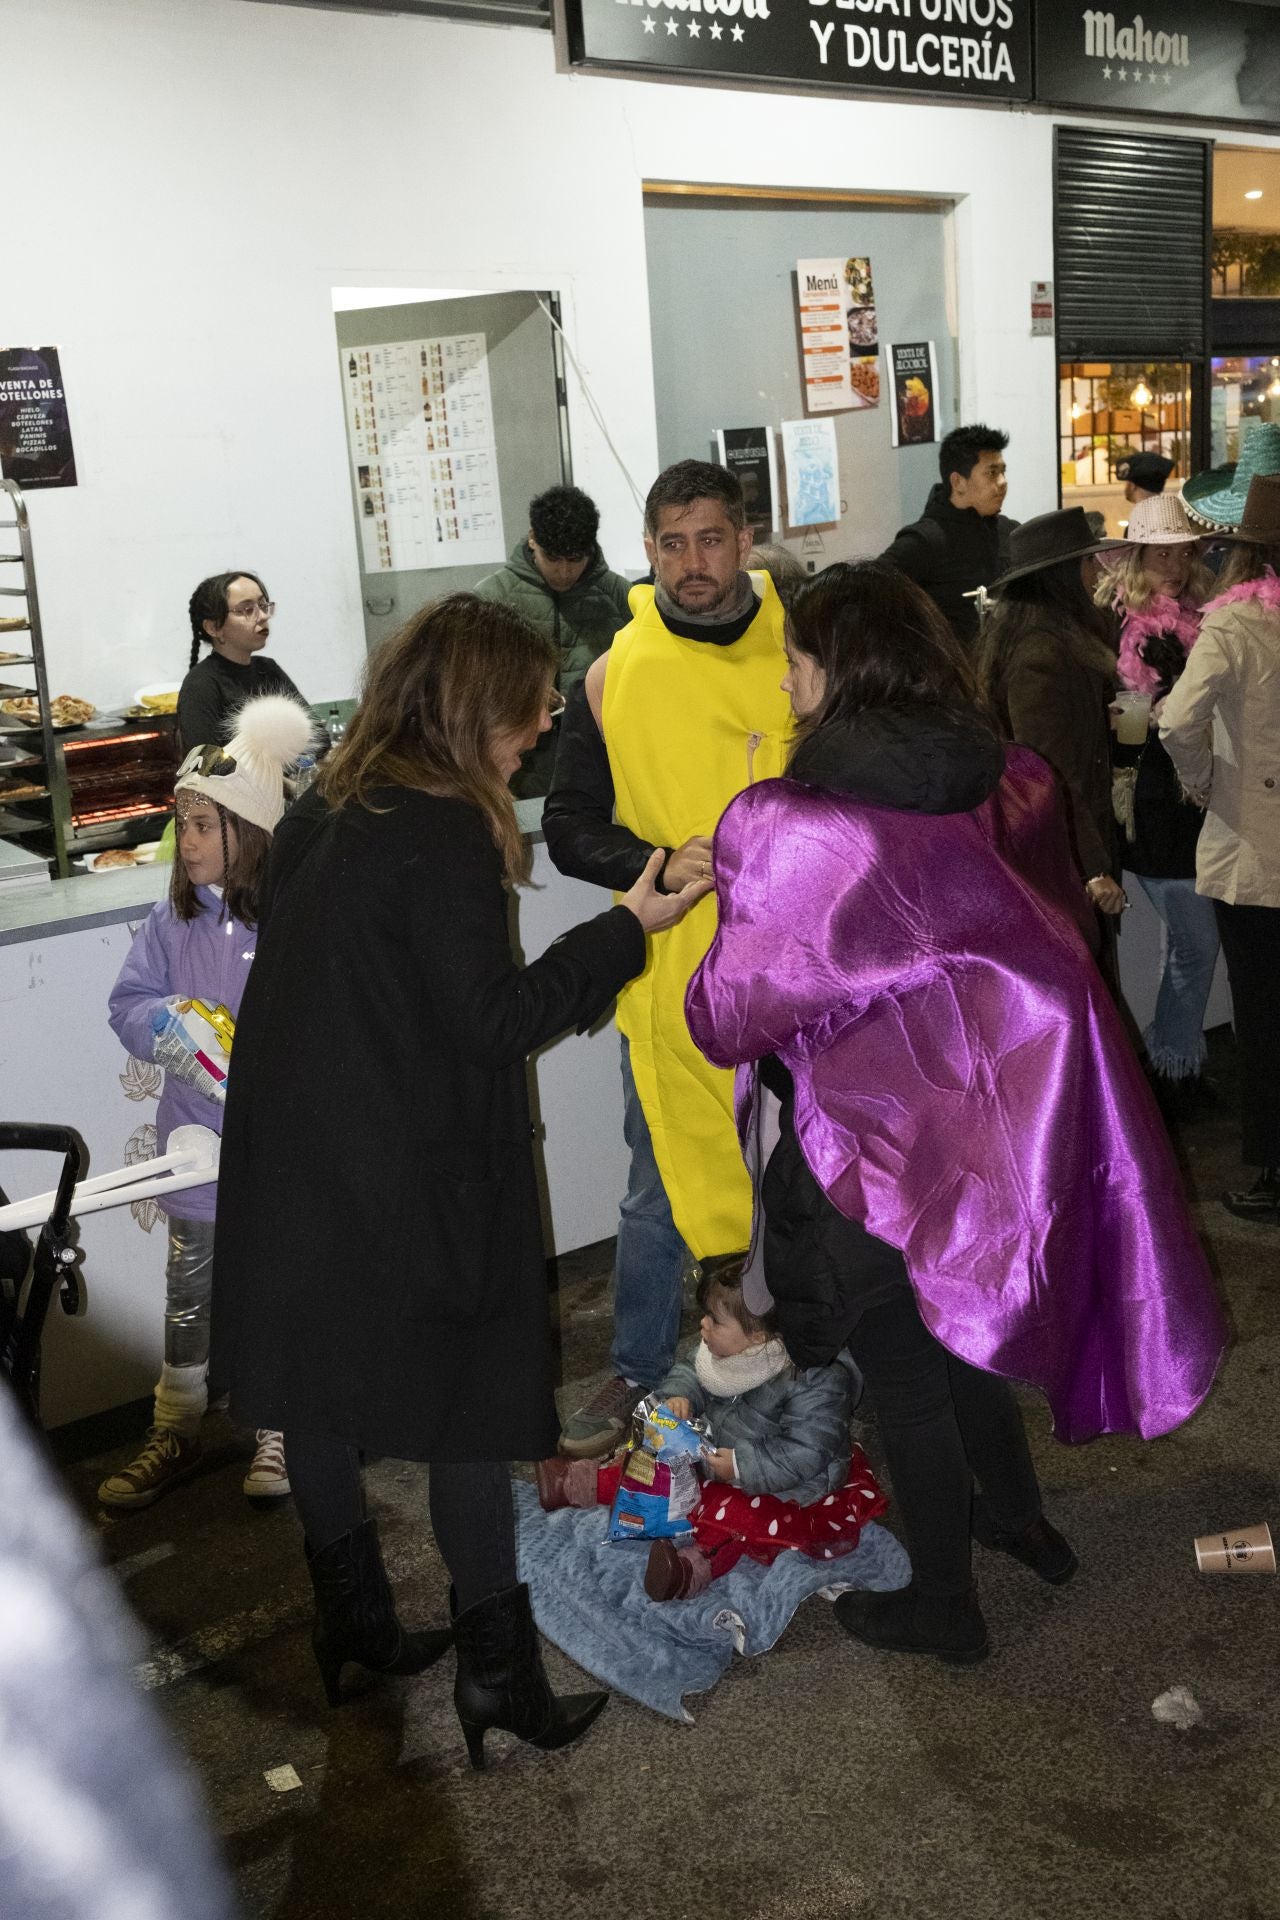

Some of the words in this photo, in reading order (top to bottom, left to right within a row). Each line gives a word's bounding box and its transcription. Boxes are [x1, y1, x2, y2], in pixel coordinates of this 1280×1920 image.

[1082, 9, 1190, 67] Mahou
[809, 19, 835, 64] Y
[843, 23, 1015, 83] DULCERÍA
[806, 273, 838, 291] Menú
[0, 380, 36, 390] VENTA
[39, 378, 53, 389] DE
[0, 389, 63, 401] OTELLONES
[15, 445, 56, 453] BOCADILLOS
